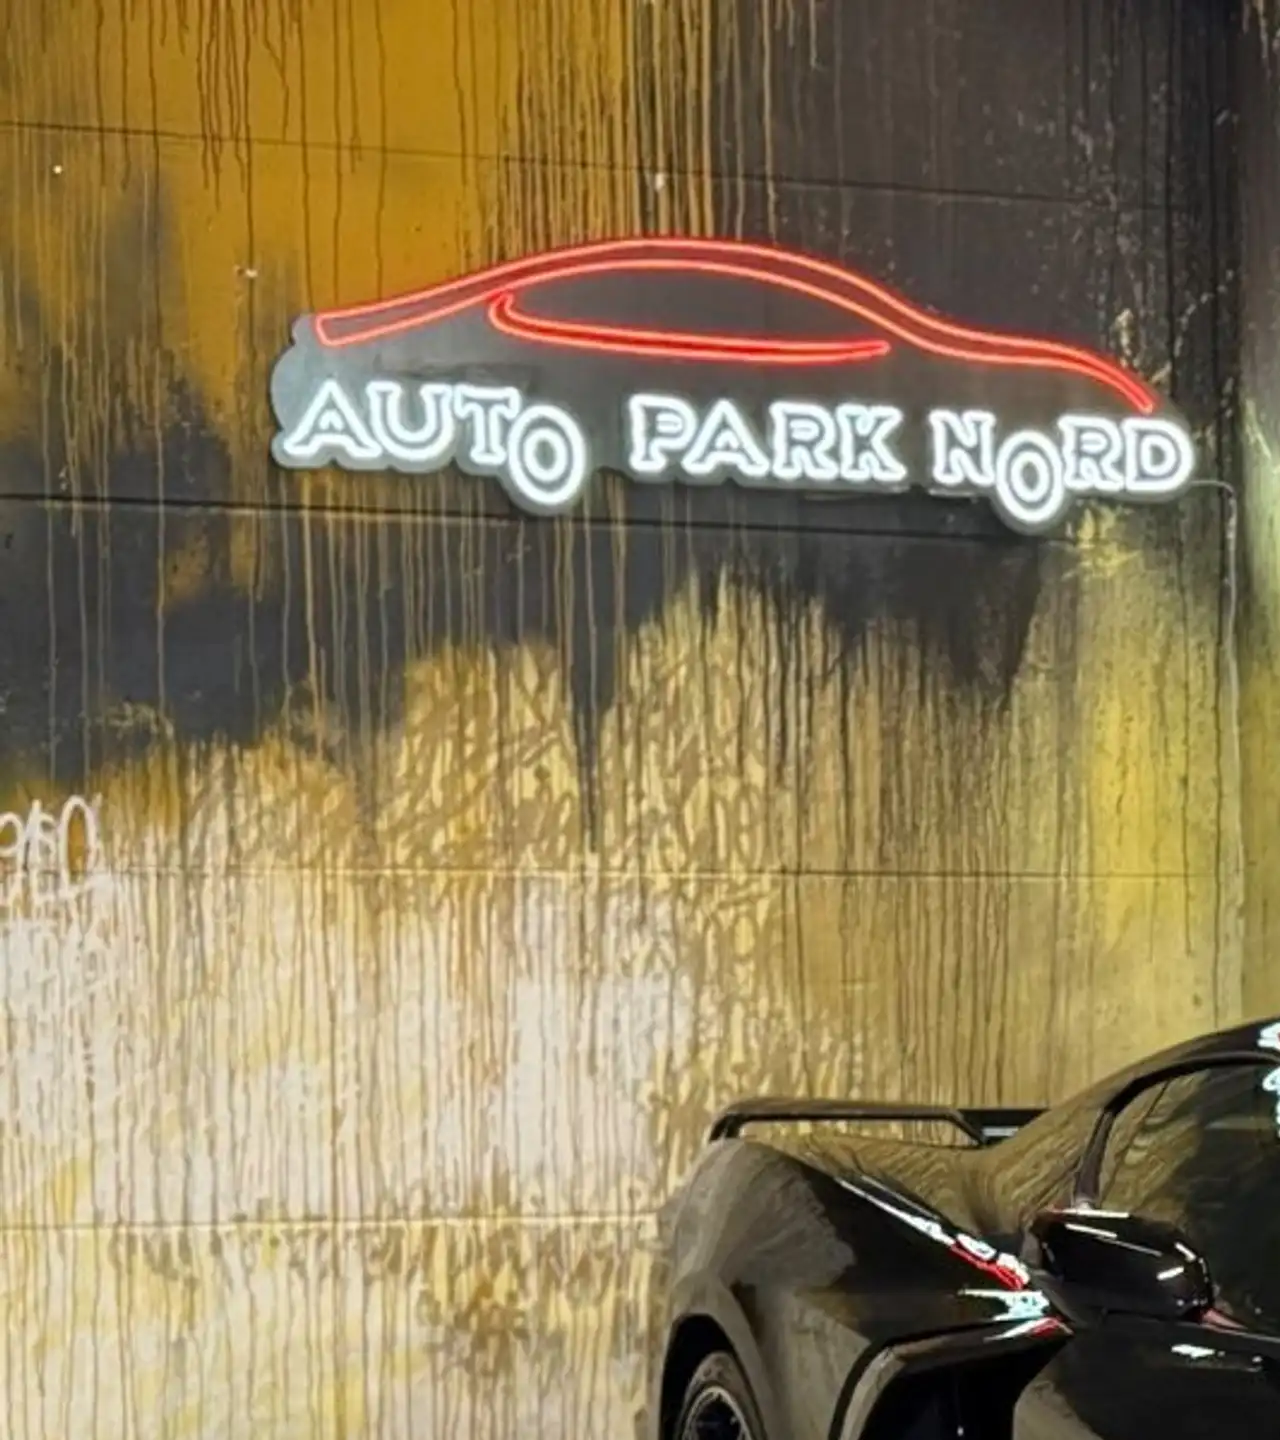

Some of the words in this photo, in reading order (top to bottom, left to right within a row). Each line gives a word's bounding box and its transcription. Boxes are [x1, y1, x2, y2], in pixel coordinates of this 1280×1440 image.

[284, 379, 587, 506] AUTO
[629, 394, 907, 481] PARK
[928, 409, 1193, 524] NORD
